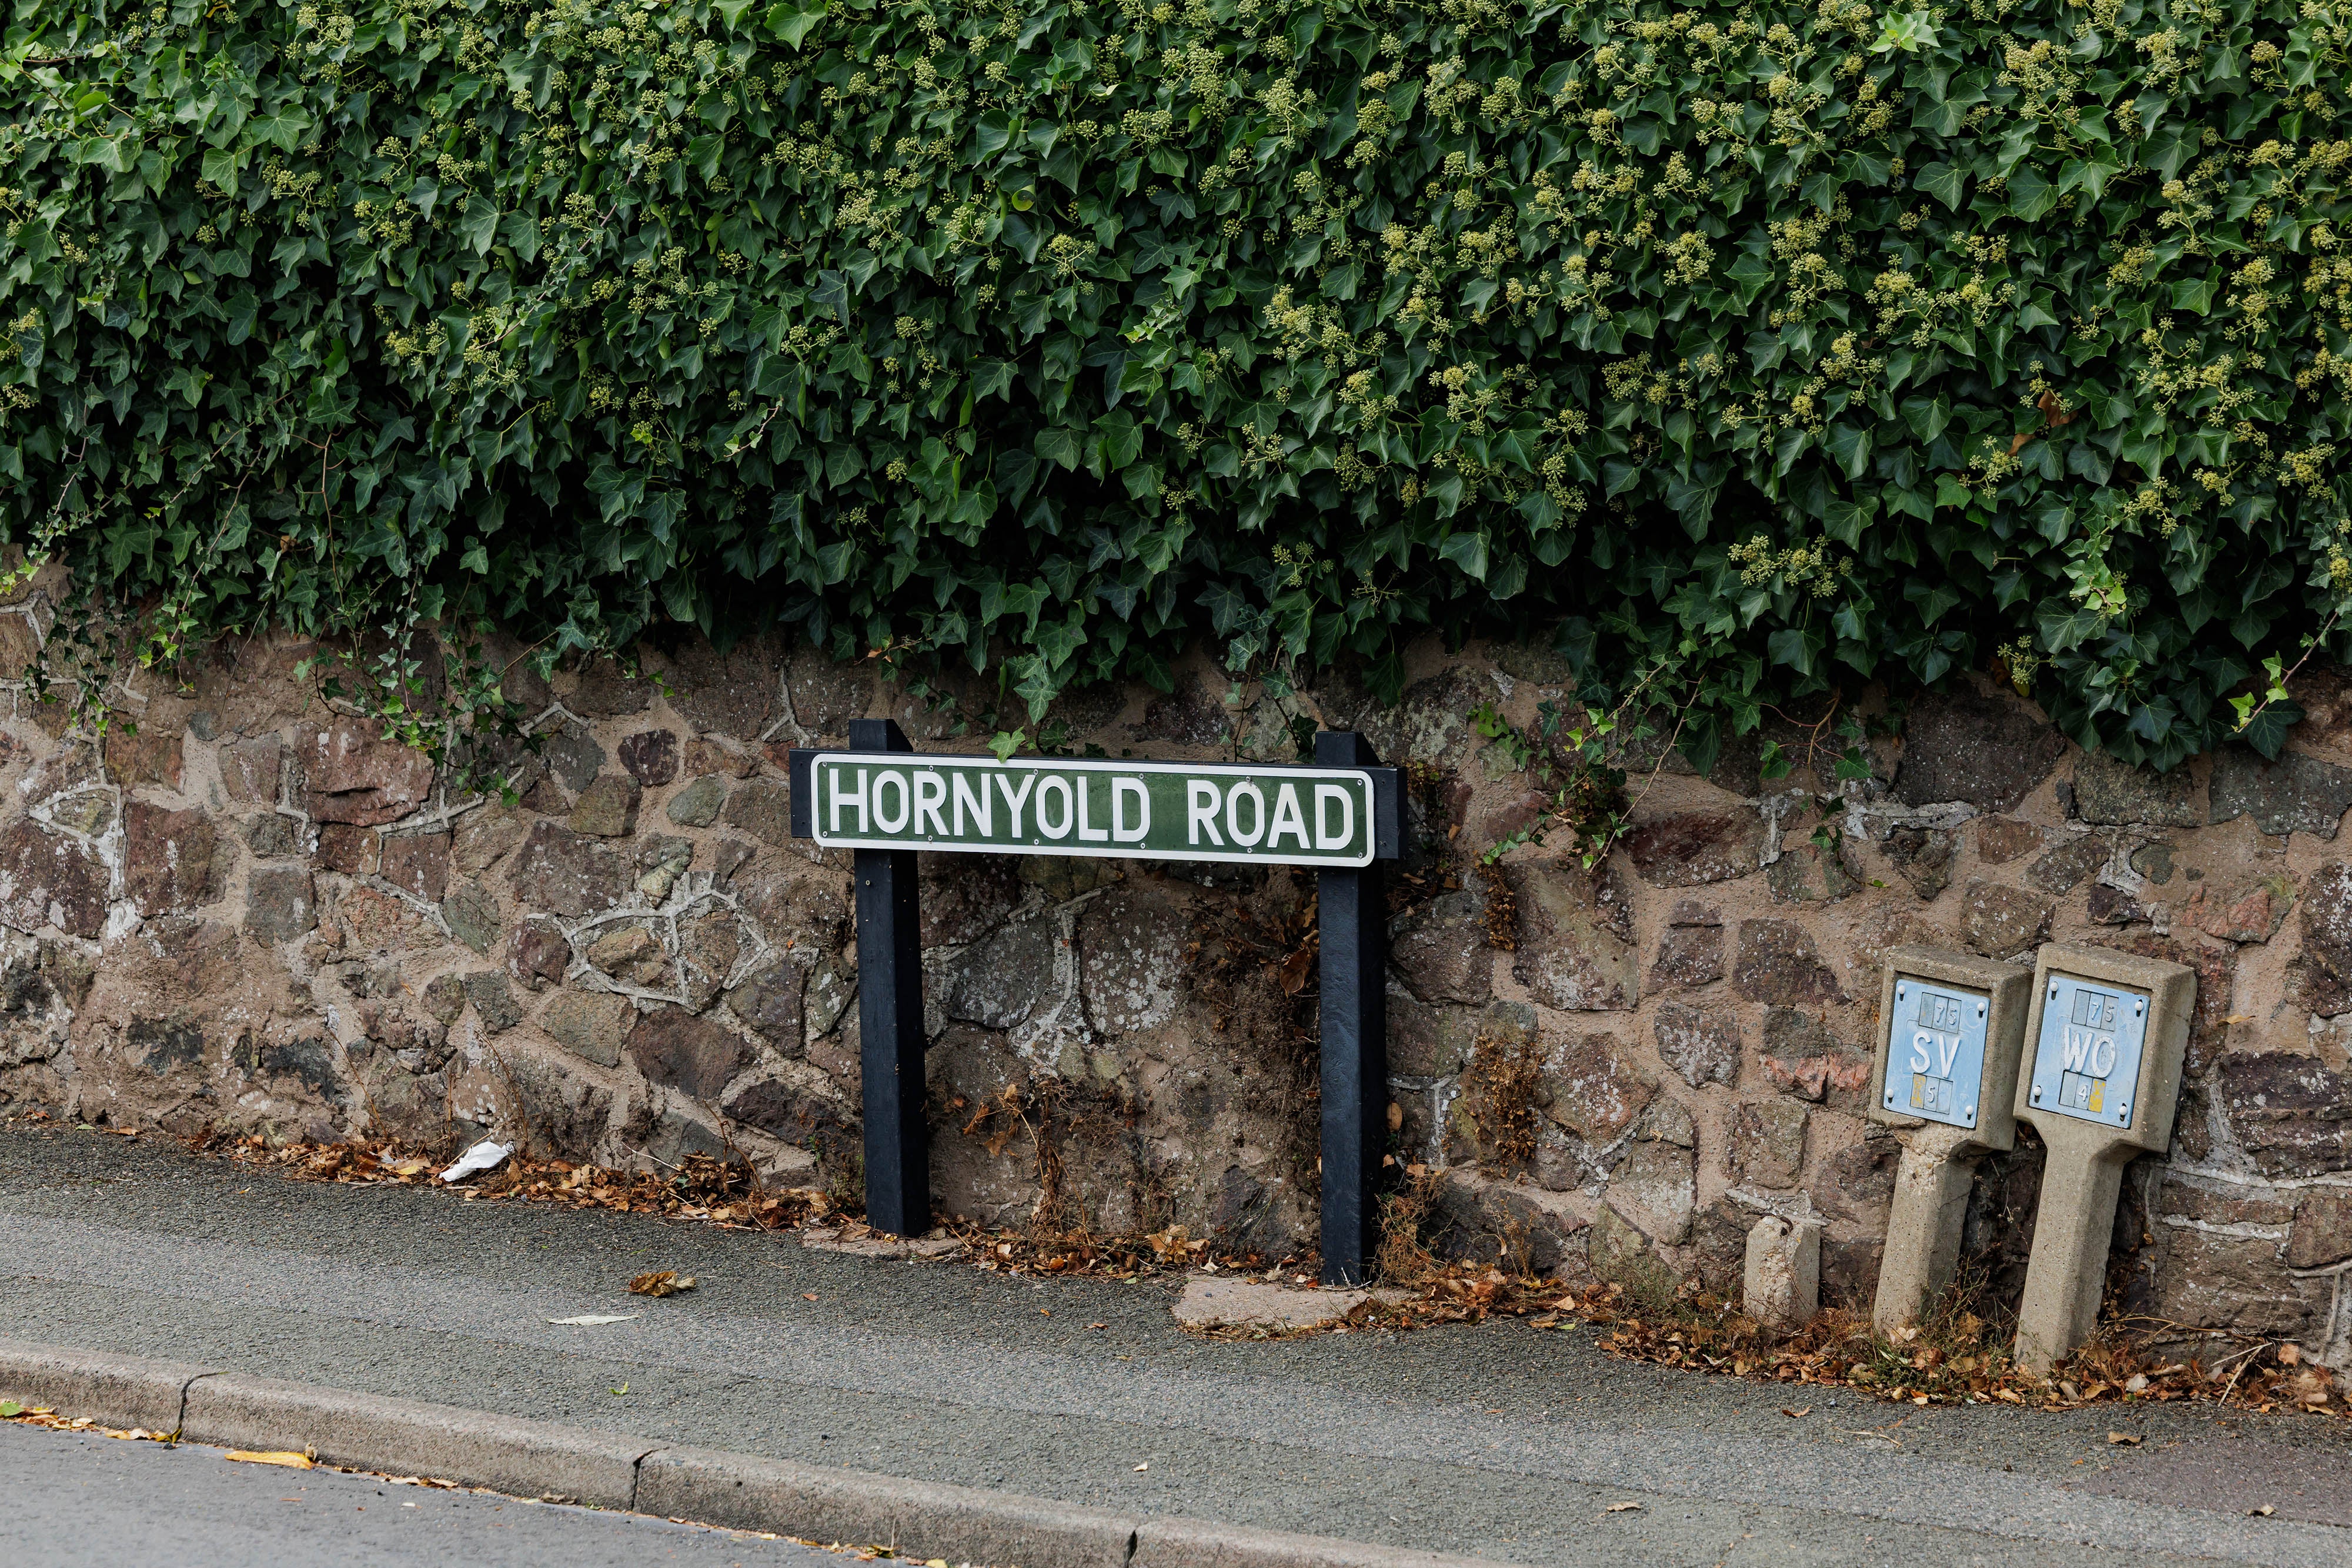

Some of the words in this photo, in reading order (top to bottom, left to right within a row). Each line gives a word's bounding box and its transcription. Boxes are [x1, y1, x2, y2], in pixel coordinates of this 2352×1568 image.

[828, 768, 1151, 842] HORNYOLD
[1187, 780, 1354, 850] ROAD
[1936, 1005, 1957, 1025] 75
[2091, 1002, 2115, 1022] 75
[1910, 1031, 1961, 1078] SV
[2064, 1025, 2116, 1078] WO
[1927, 1086, 1936, 1103] 5
[2078, 1085, 2088, 1102] 4
